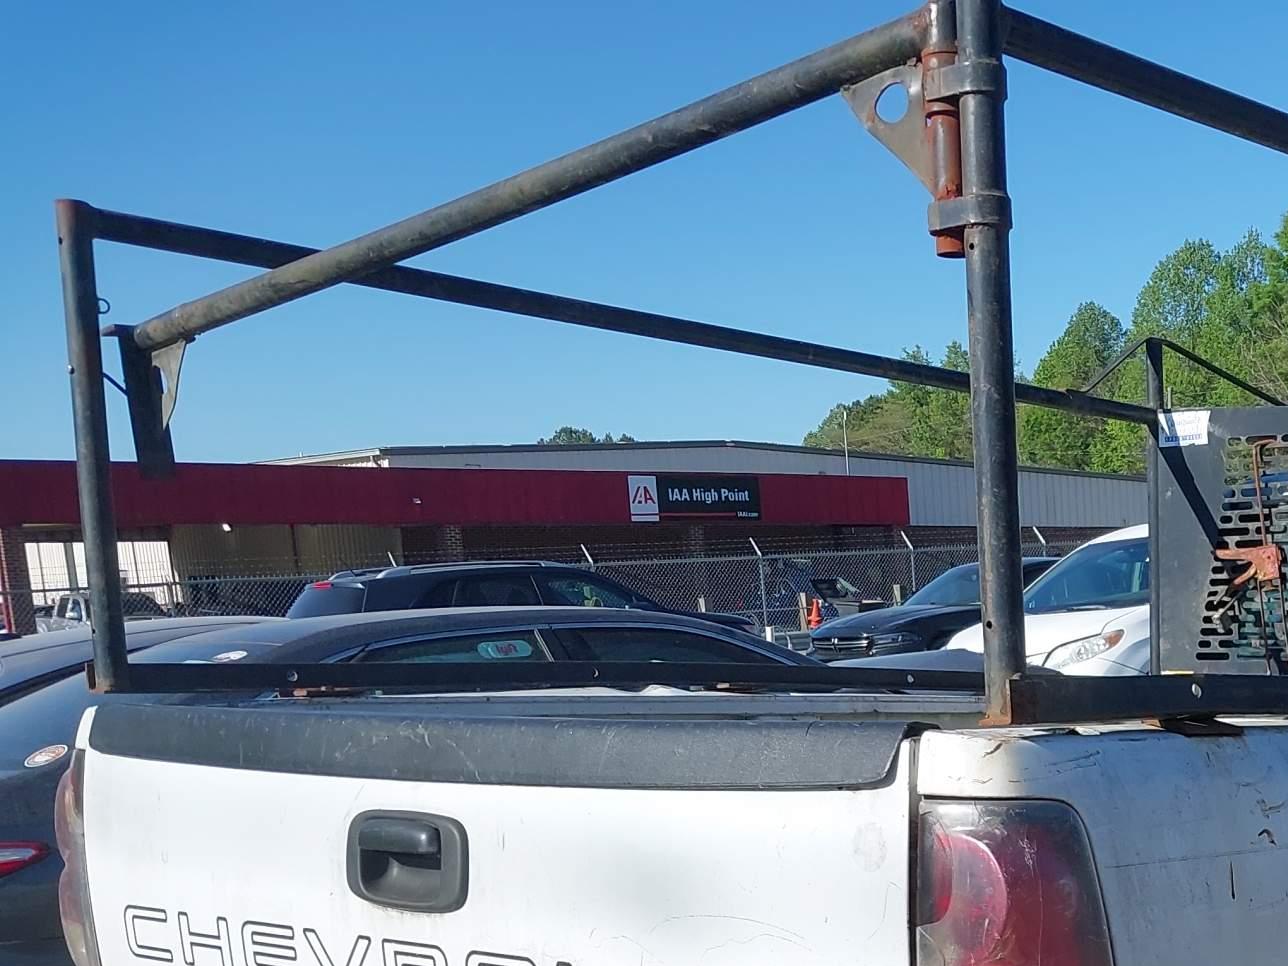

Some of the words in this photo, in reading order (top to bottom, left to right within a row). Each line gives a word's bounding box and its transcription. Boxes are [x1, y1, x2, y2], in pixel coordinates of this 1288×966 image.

[668, 488, 690, 502] IAA
[693, 488, 718, 504] High
[721, 488, 750, 502] Point
